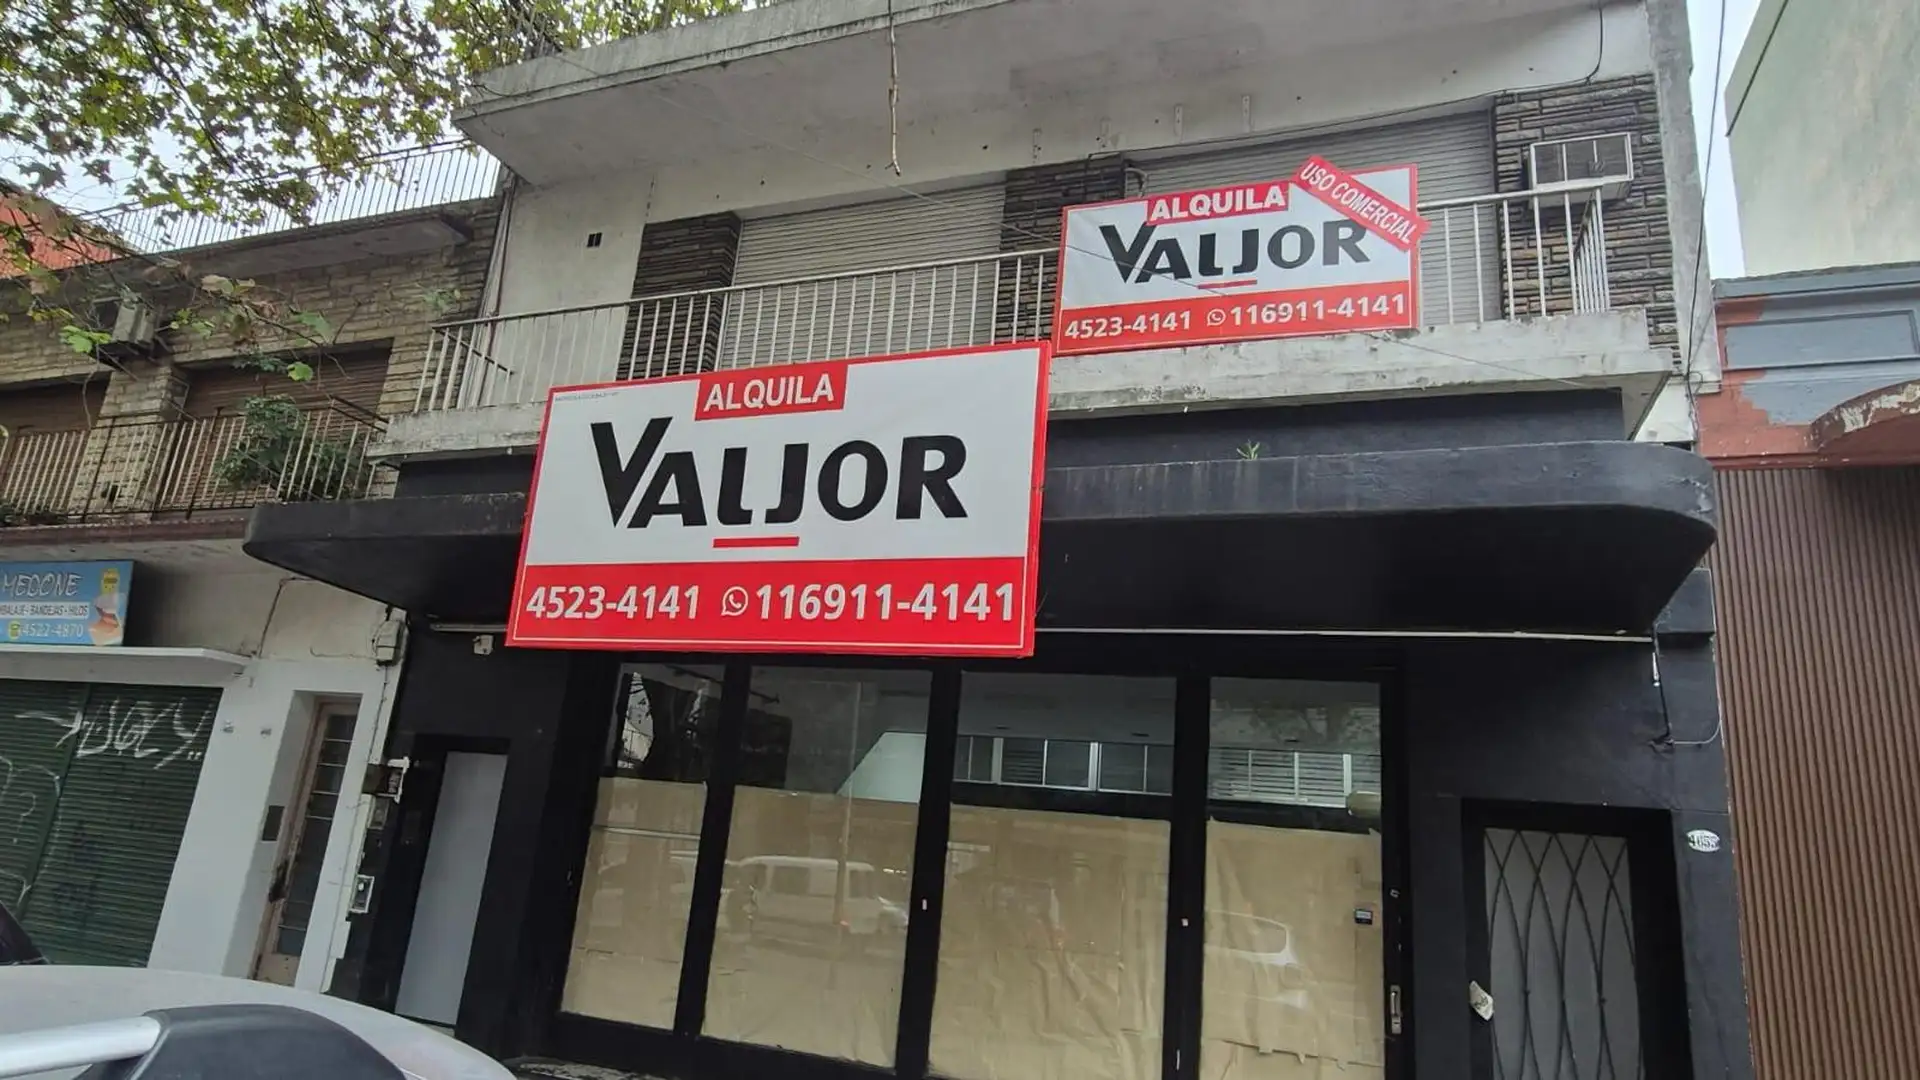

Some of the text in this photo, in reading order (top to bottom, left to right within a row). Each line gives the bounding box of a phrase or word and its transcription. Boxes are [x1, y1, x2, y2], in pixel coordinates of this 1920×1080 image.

[1150, 185, 1287, 221] ALQUILA
[1300, 162, 1417, 244] USO COMERCIAL
[1099, 218, 1371, 284] VALJOR
[1064, 293, 1405, 339] 4523-4141 116911-4141
[703, 372, 835, 413] ALQUILA
[590, 416, 968, 529] VALJOR
[526, 581, 1014, 621] 4523-4141 116911-4141
